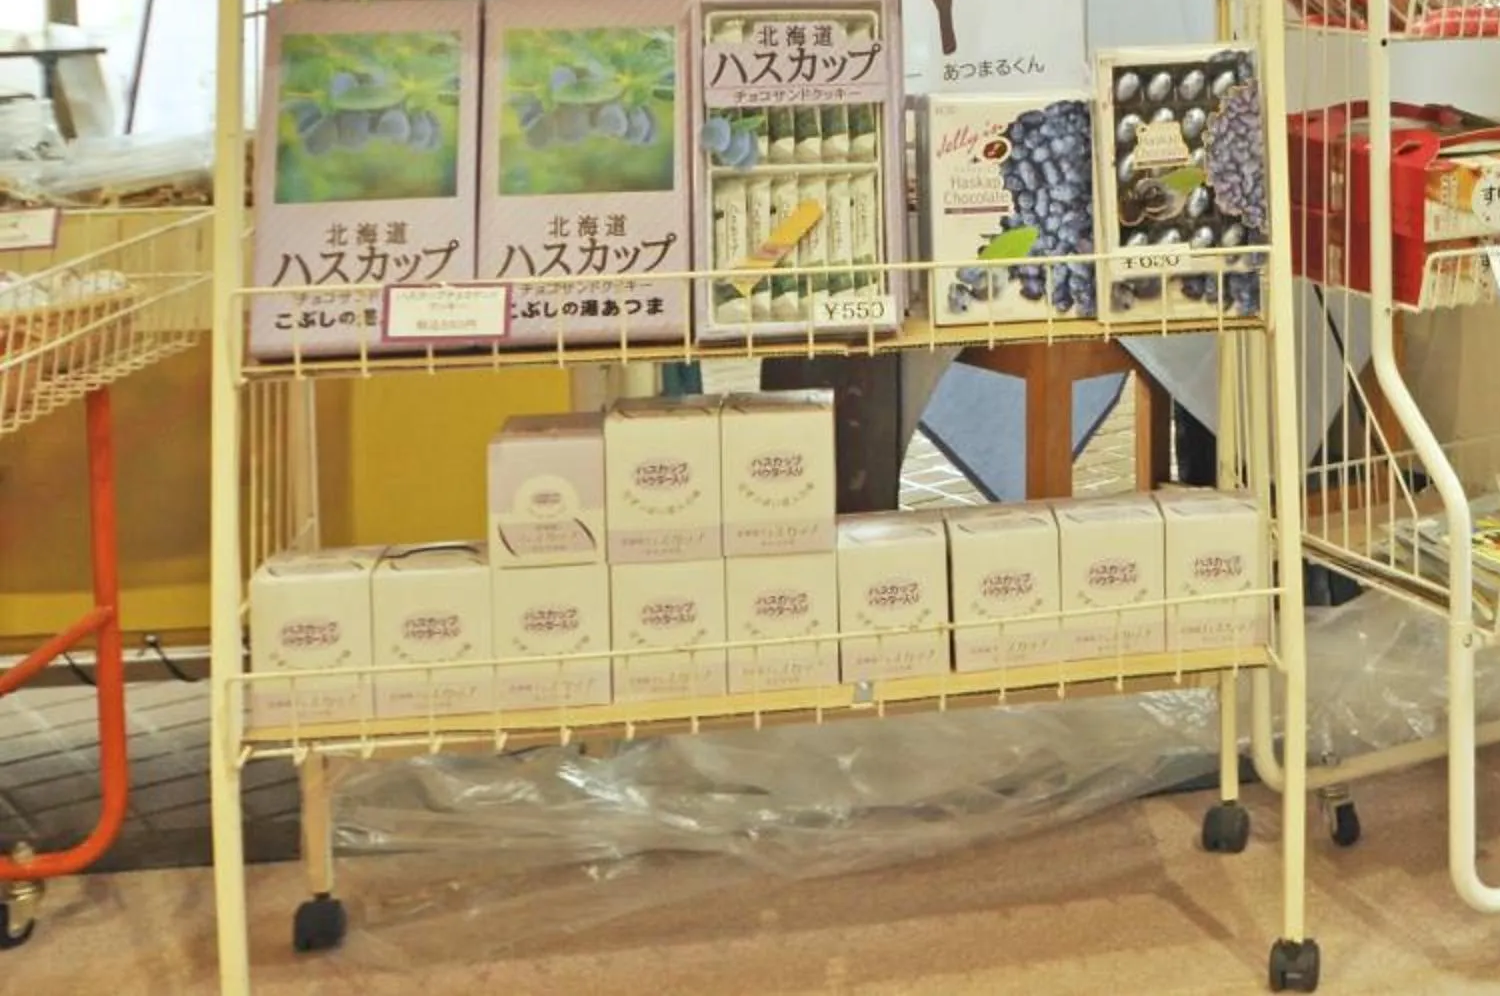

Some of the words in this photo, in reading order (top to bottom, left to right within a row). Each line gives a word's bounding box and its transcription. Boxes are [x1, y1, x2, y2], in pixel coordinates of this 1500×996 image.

[758, 24, 834, 46] 北海道
[711, 44, 882, 86] ハスカップ
[943, 60, 1044, 81] あつまるくん
[326, 221, 408, 246] 北海道
[548, 214, 627, 237] 北海道
[272, 239, 460, 287] ハスカップ
[496, 232, 677, 279] ハスカップ
